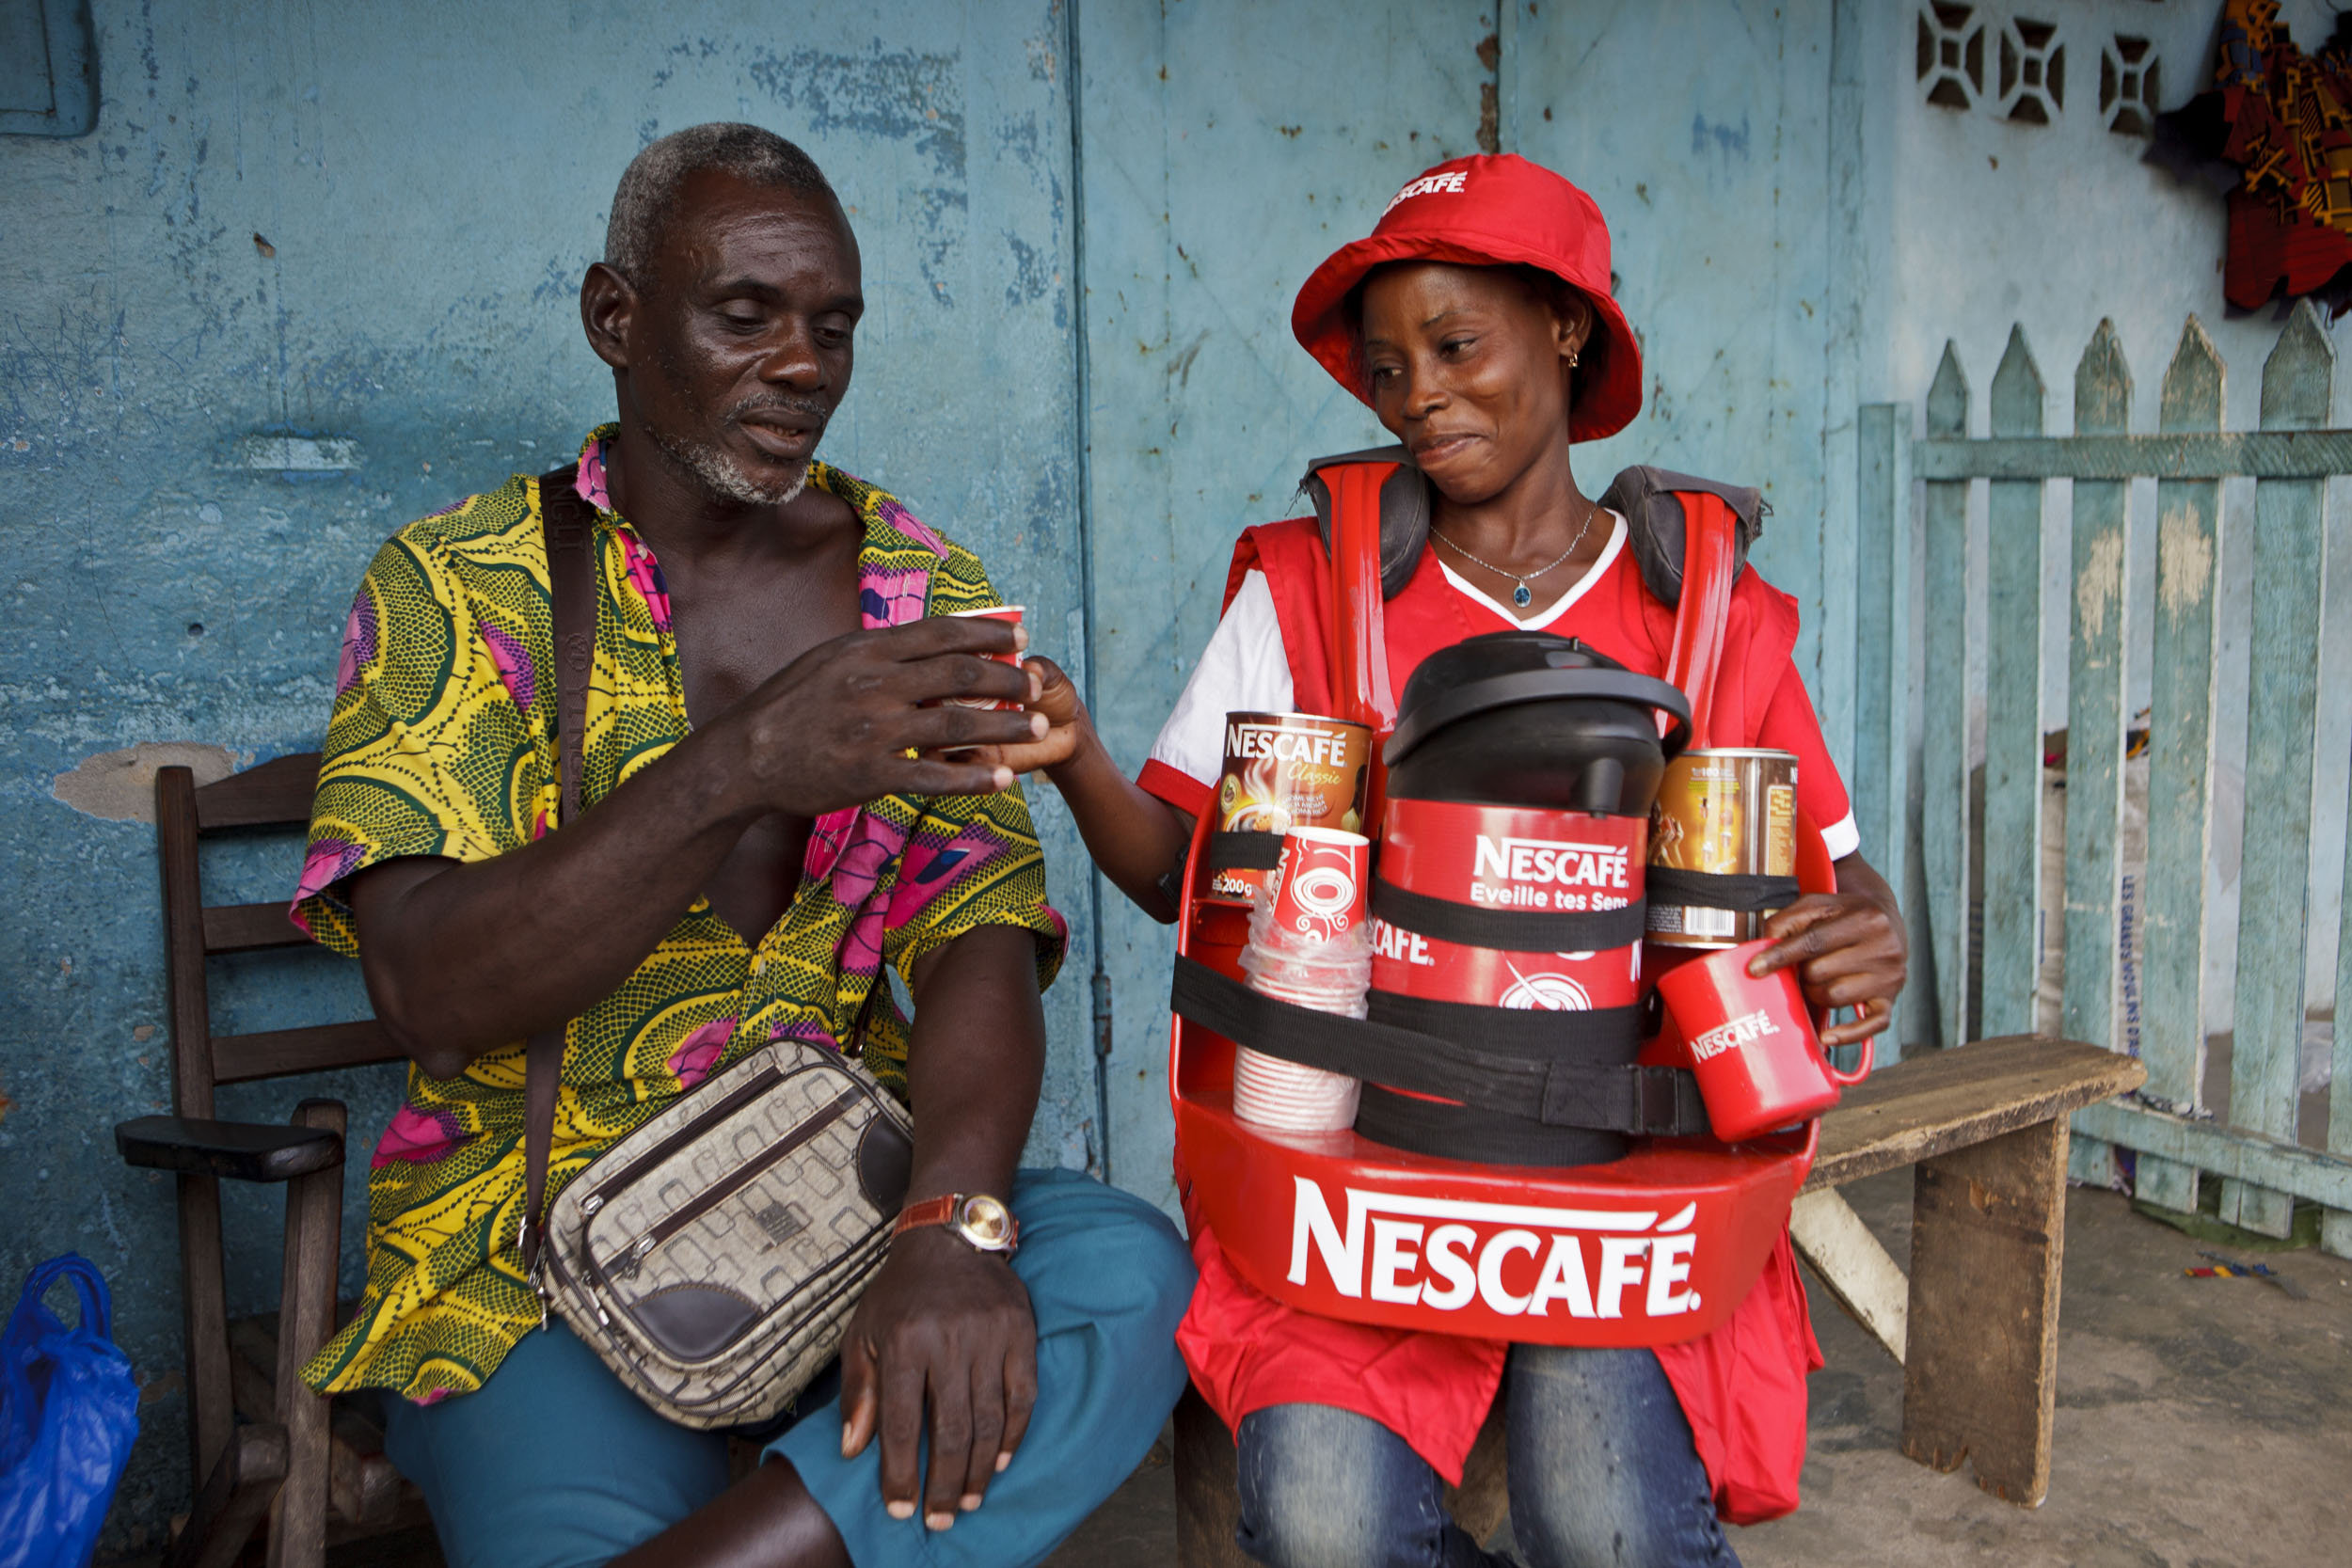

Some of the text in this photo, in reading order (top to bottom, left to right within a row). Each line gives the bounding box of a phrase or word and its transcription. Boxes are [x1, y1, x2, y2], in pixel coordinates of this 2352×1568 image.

[1226, 723, 1347, 768] NESCAFÉ
[1287, 760, 1343, 785] Classic
[1472, 834, 1629, 888] NESCAFÉ
[1470, 881, 1548, 908] Eveille
[1555, 893, 1586, 911] tes
[1690, 1008, 1777, 1064] NESCAFÉ
[1287, 1175, 1701, 1319] NESCAFÉ
